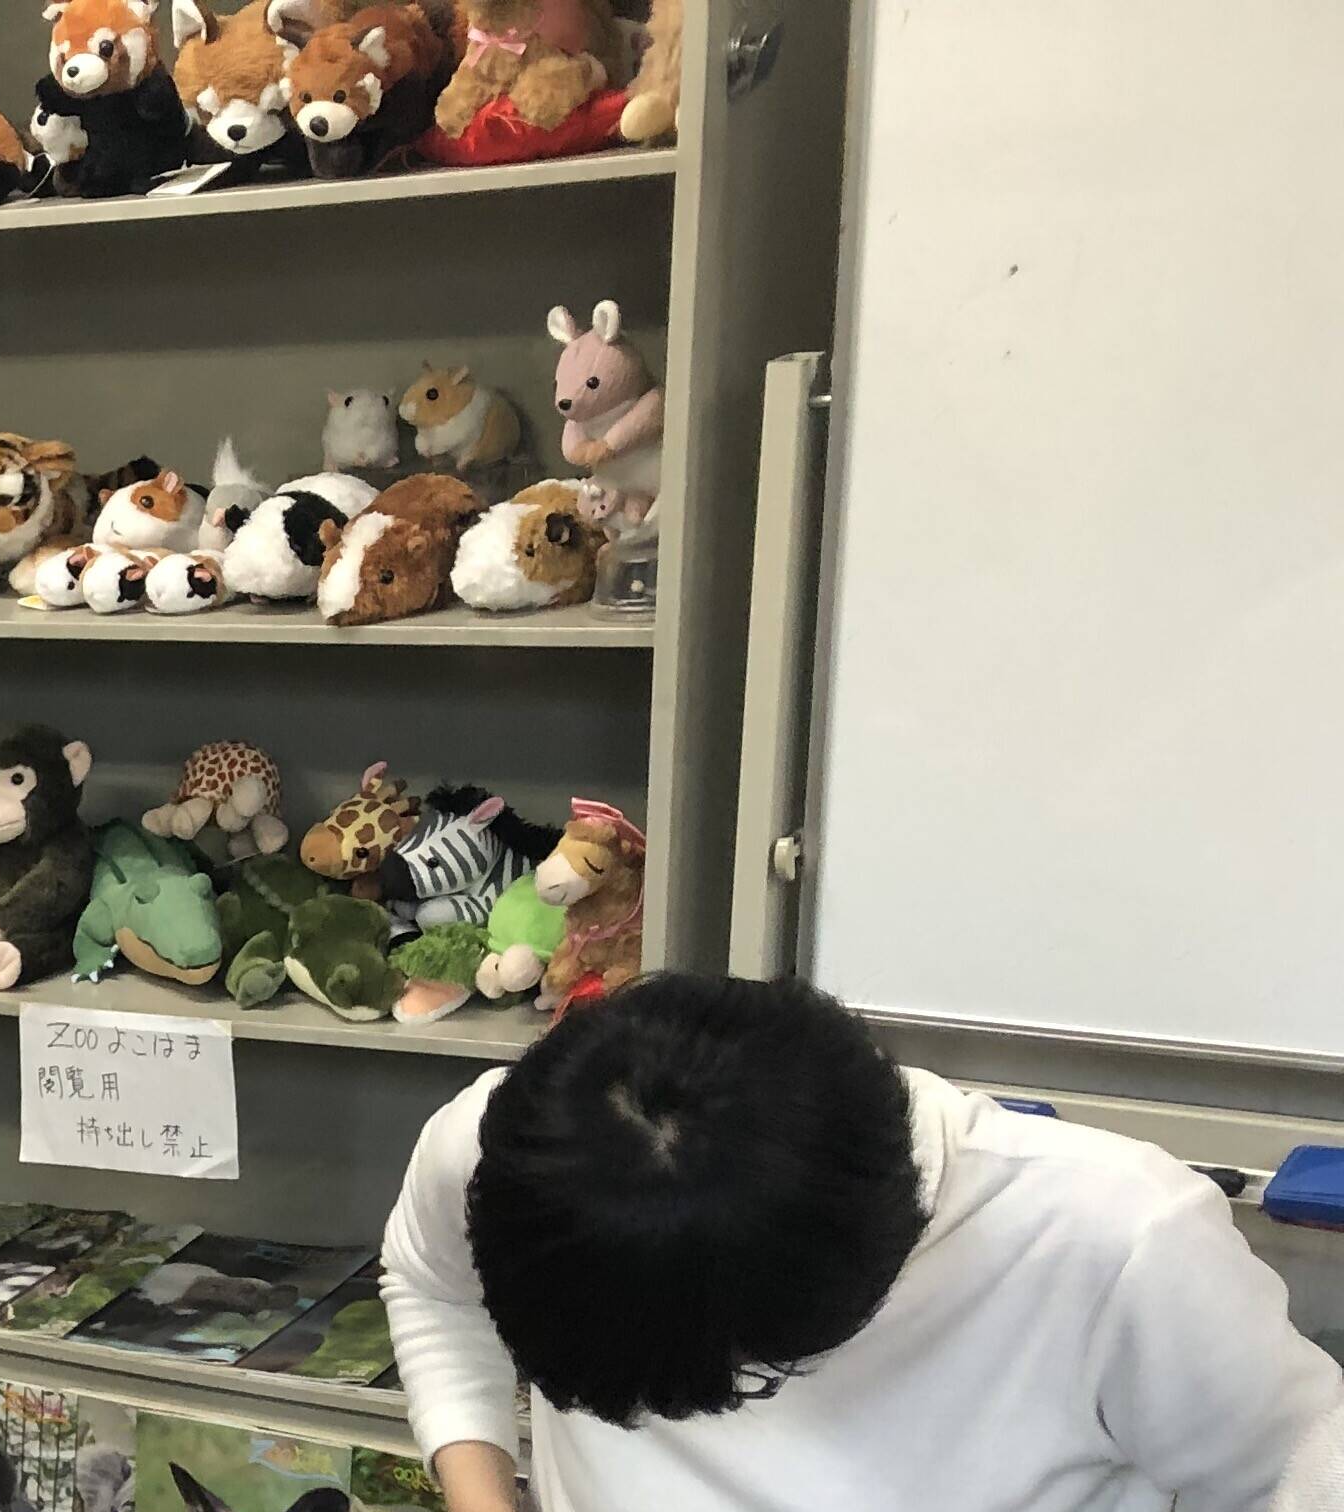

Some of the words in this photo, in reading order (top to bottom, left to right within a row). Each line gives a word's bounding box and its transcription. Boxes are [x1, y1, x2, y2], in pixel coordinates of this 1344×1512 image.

[76, 1116, 213, 1158] 持ち出し禁止
